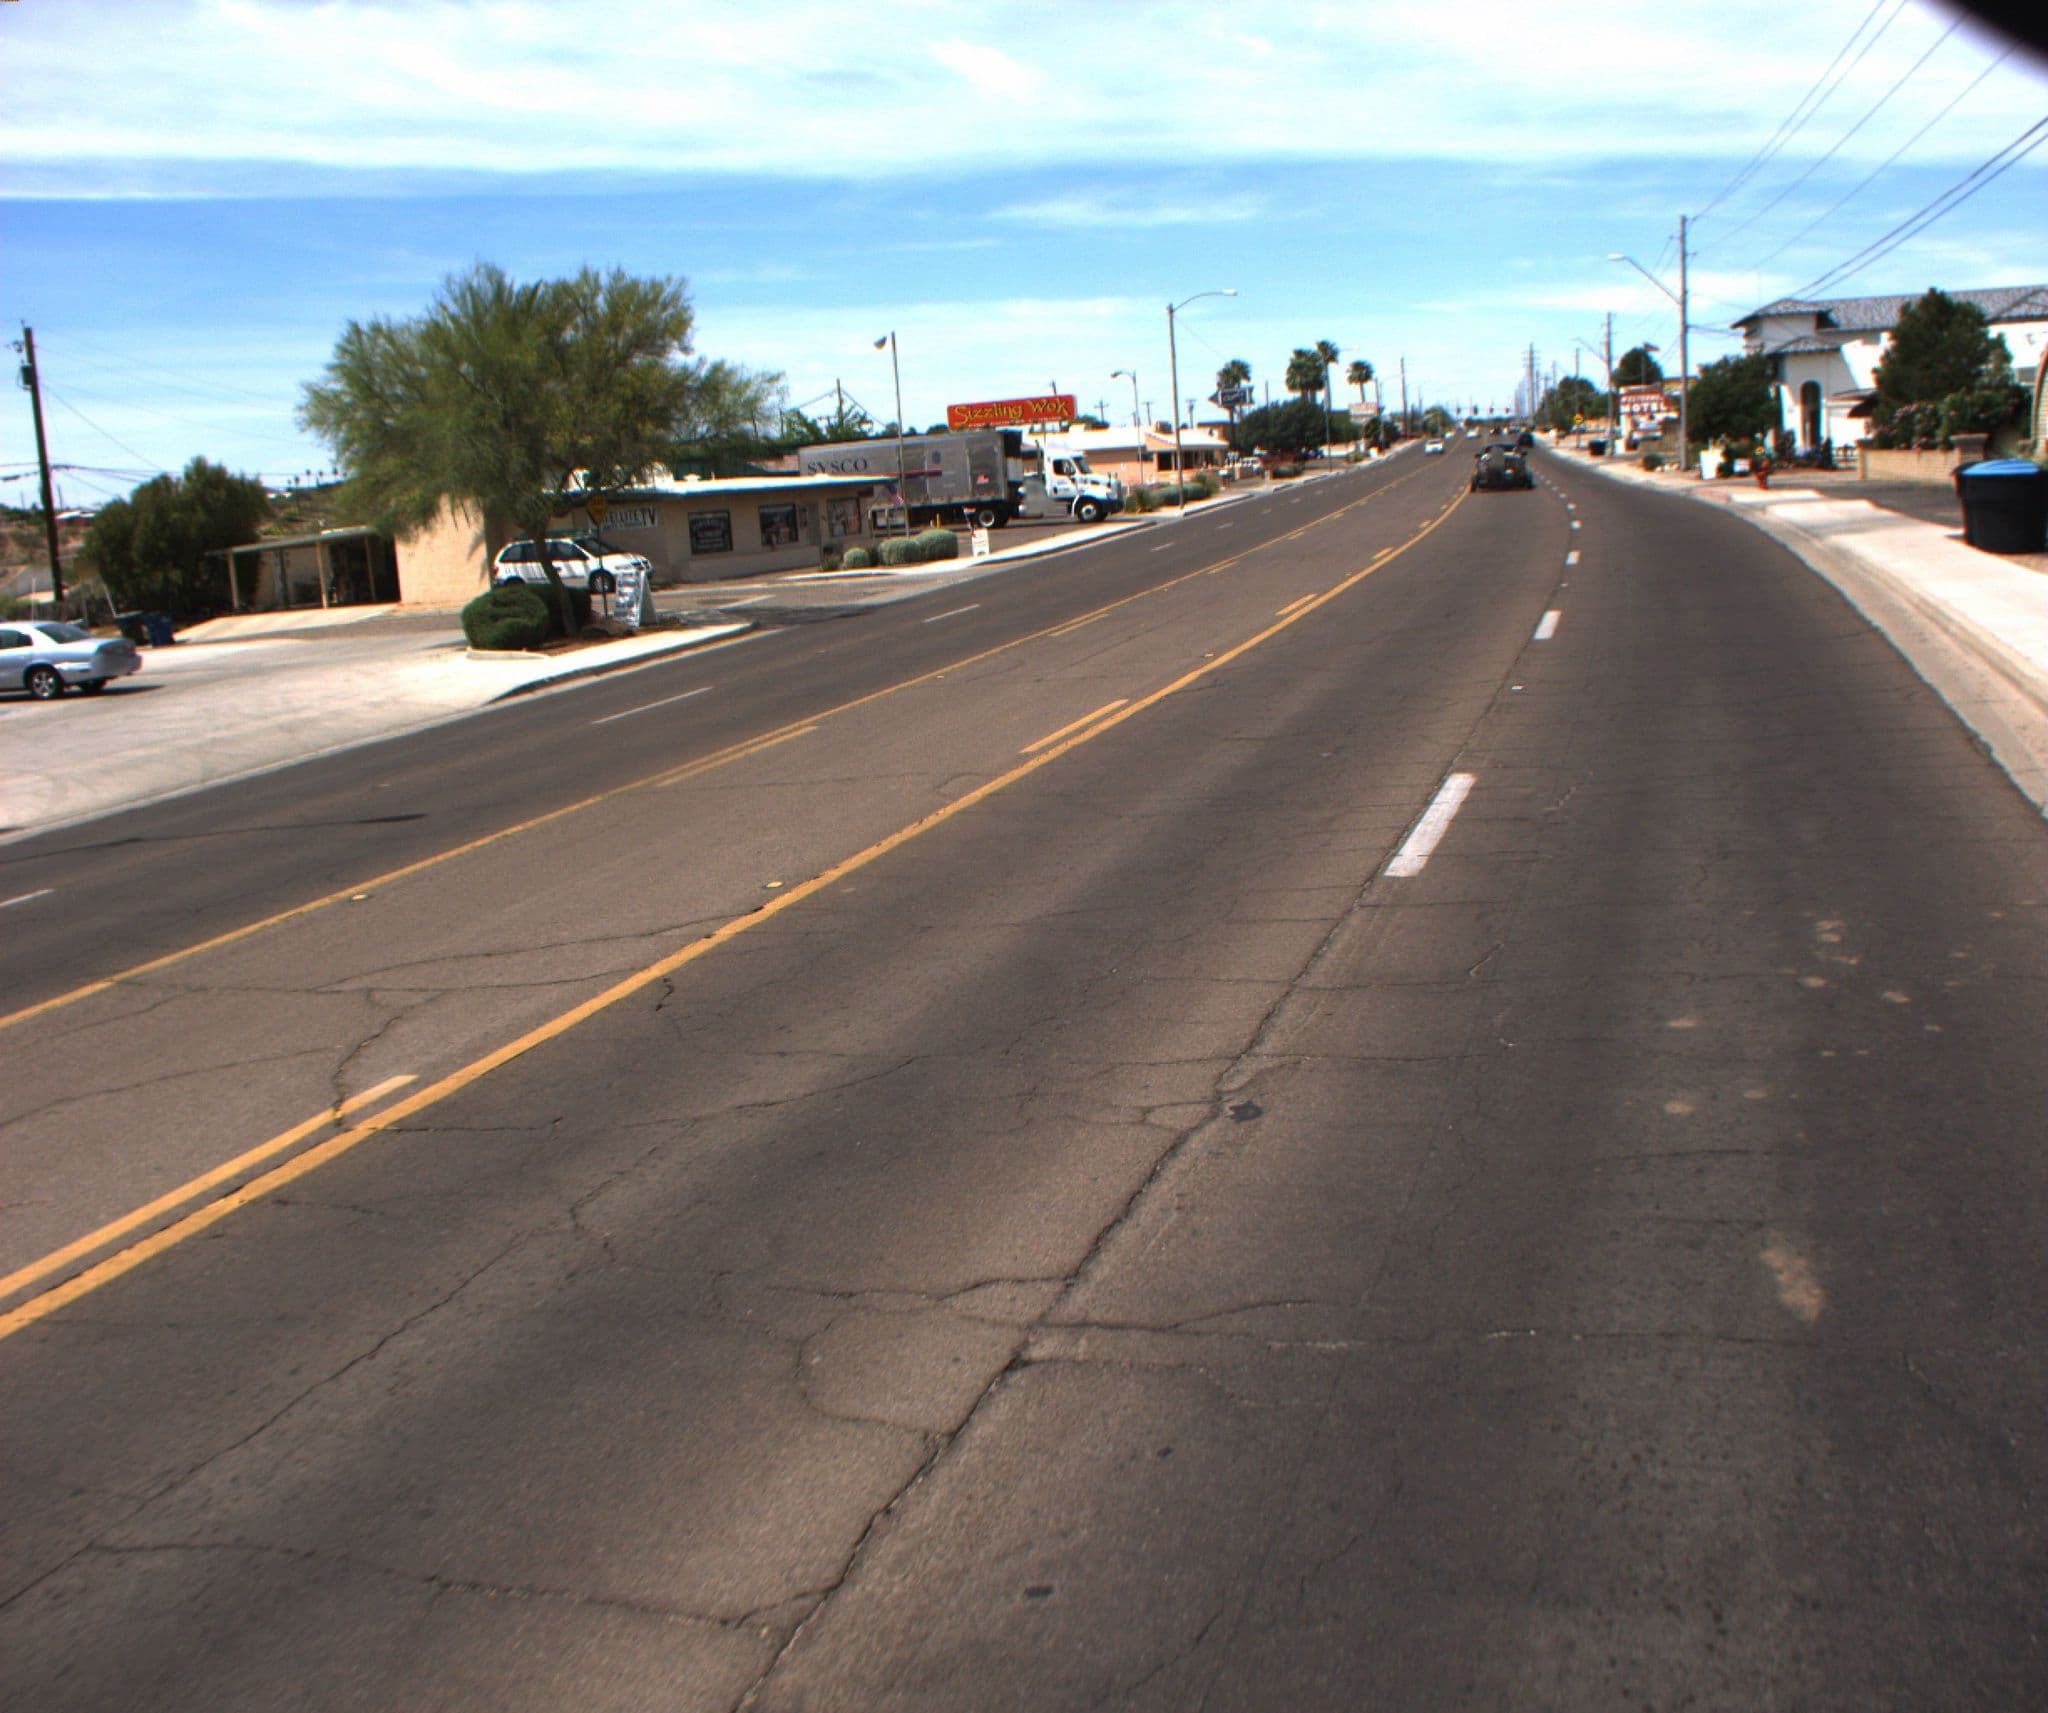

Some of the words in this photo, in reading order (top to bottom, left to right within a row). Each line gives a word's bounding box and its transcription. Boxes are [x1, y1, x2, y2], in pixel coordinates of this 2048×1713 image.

[954, 402, 1024, 425] Sizzling
[1025, 397, 1069, 417] Wok
[1619, 402, 1668, 414] MOTEL
[807, 455, 868, 474] SYSCO
